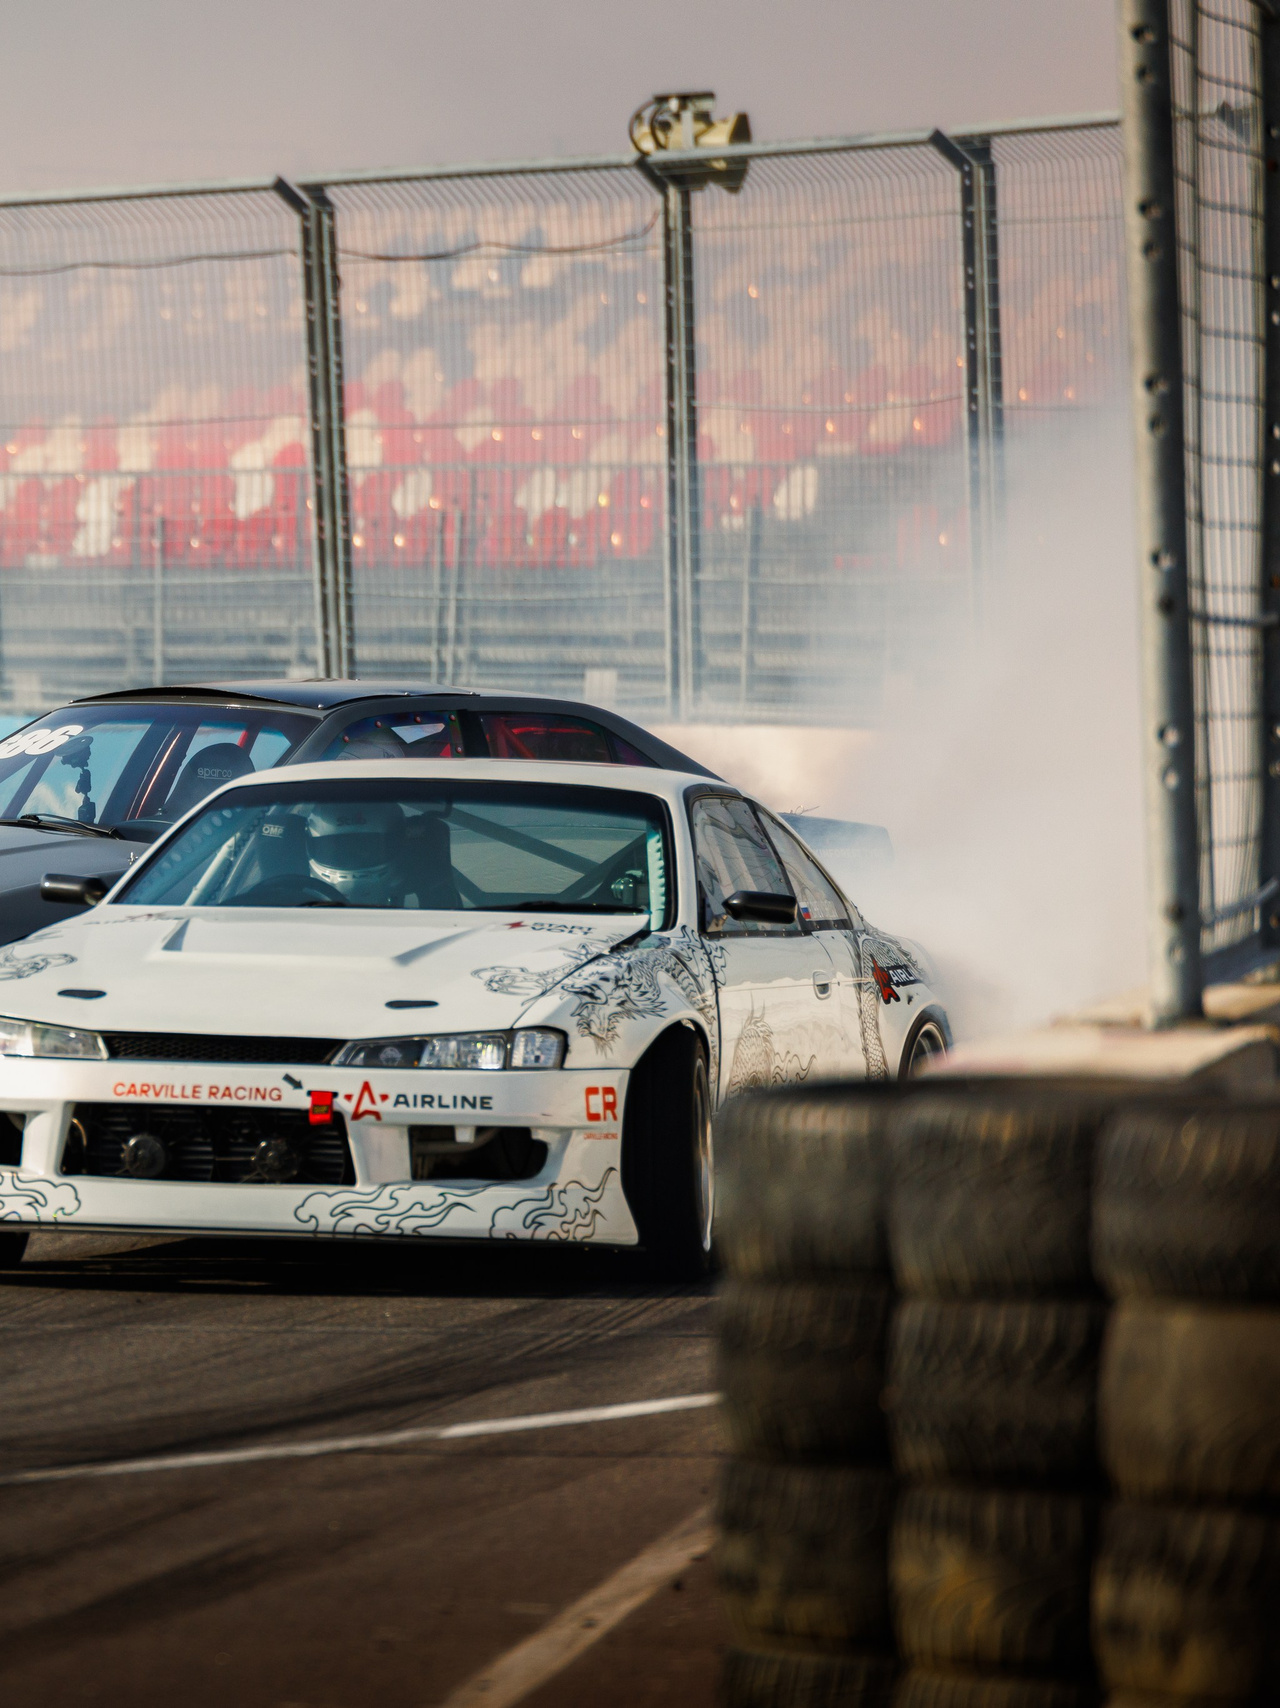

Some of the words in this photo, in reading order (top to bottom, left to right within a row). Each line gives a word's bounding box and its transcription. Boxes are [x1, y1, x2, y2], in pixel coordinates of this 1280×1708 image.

[197, 767, 232, 779] sparco
[262, 826, 284, 836] OMP
[531, 926, 593, 935] VOLT
[532, 922, 597, 932] START
[113, 1082, 202, 1100] CARVILLE
[208, 1085, 282, 1102] RACING
[393, 1093, 493, 1111] AIRLINE
[585, 1086, 618, 1121] CR
